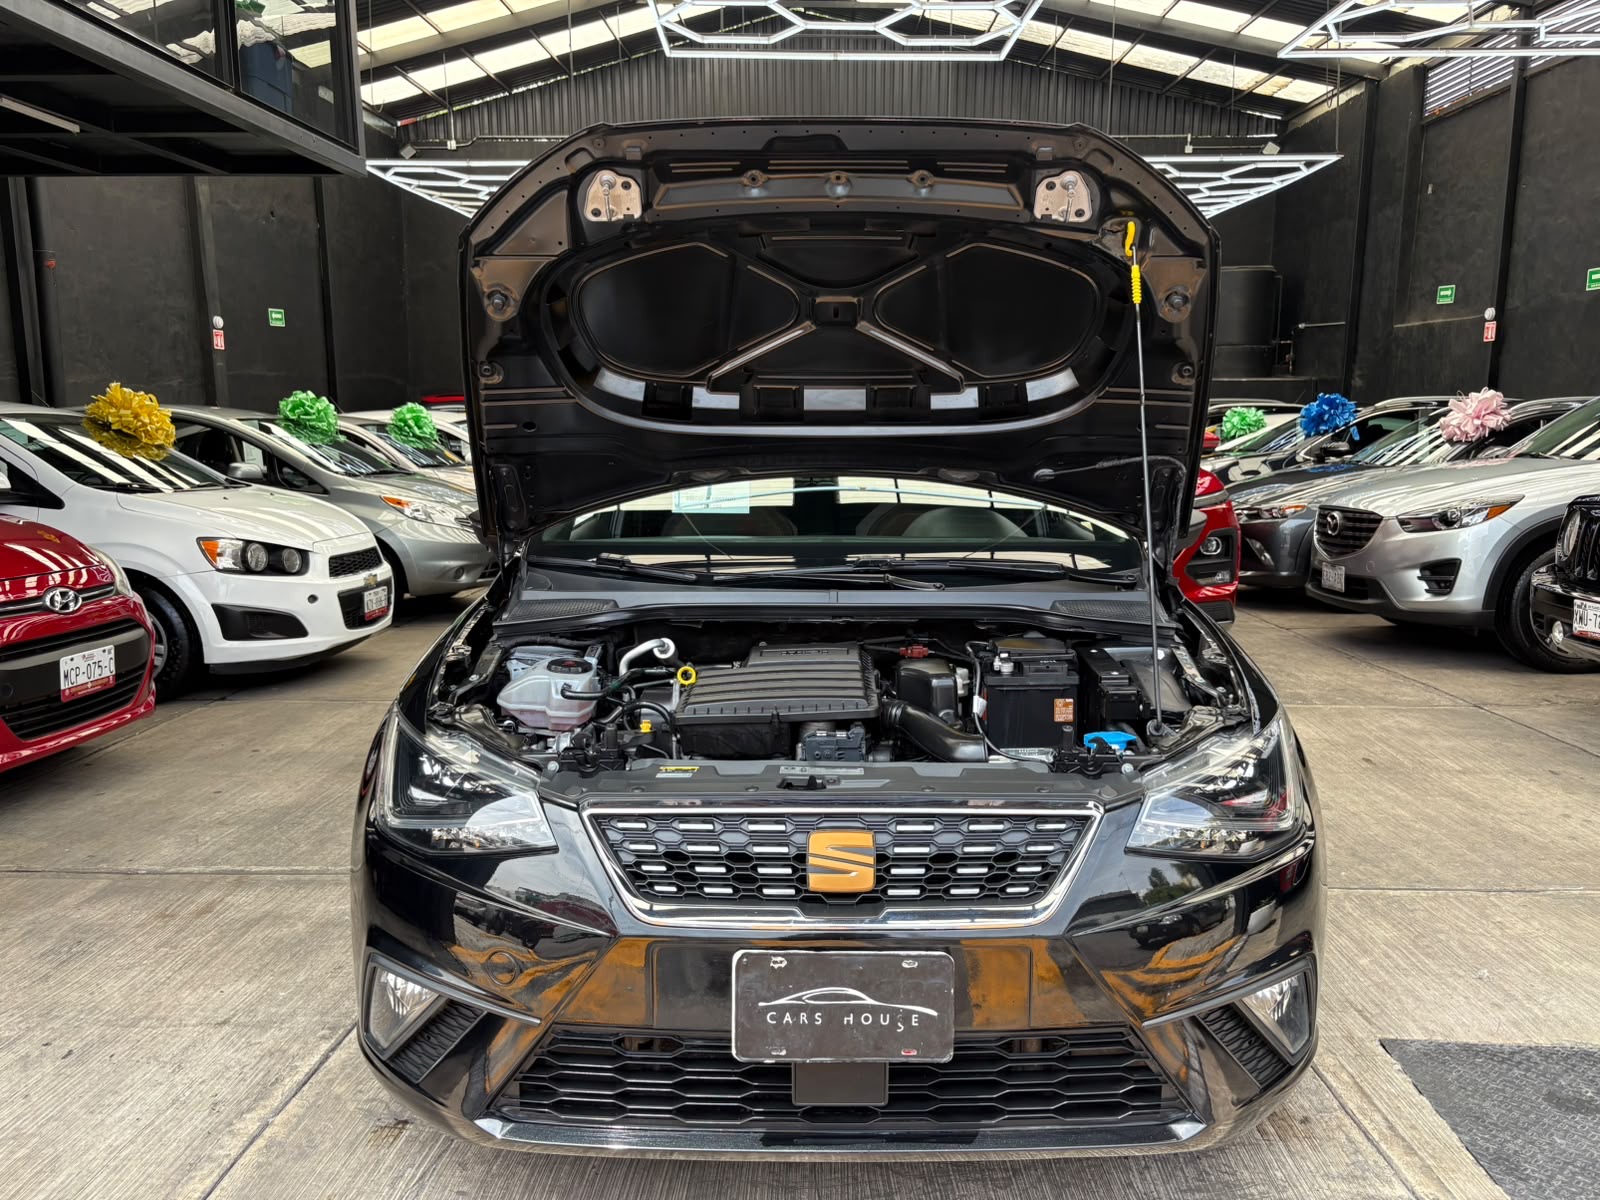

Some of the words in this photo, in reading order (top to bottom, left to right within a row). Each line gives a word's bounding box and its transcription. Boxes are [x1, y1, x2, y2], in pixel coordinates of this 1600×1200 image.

[63, 657, 114, 688] MCP-075-C
[766, 1011, 823, 1025] CARS
[843, 1012, 920, 1032] HOUSE
